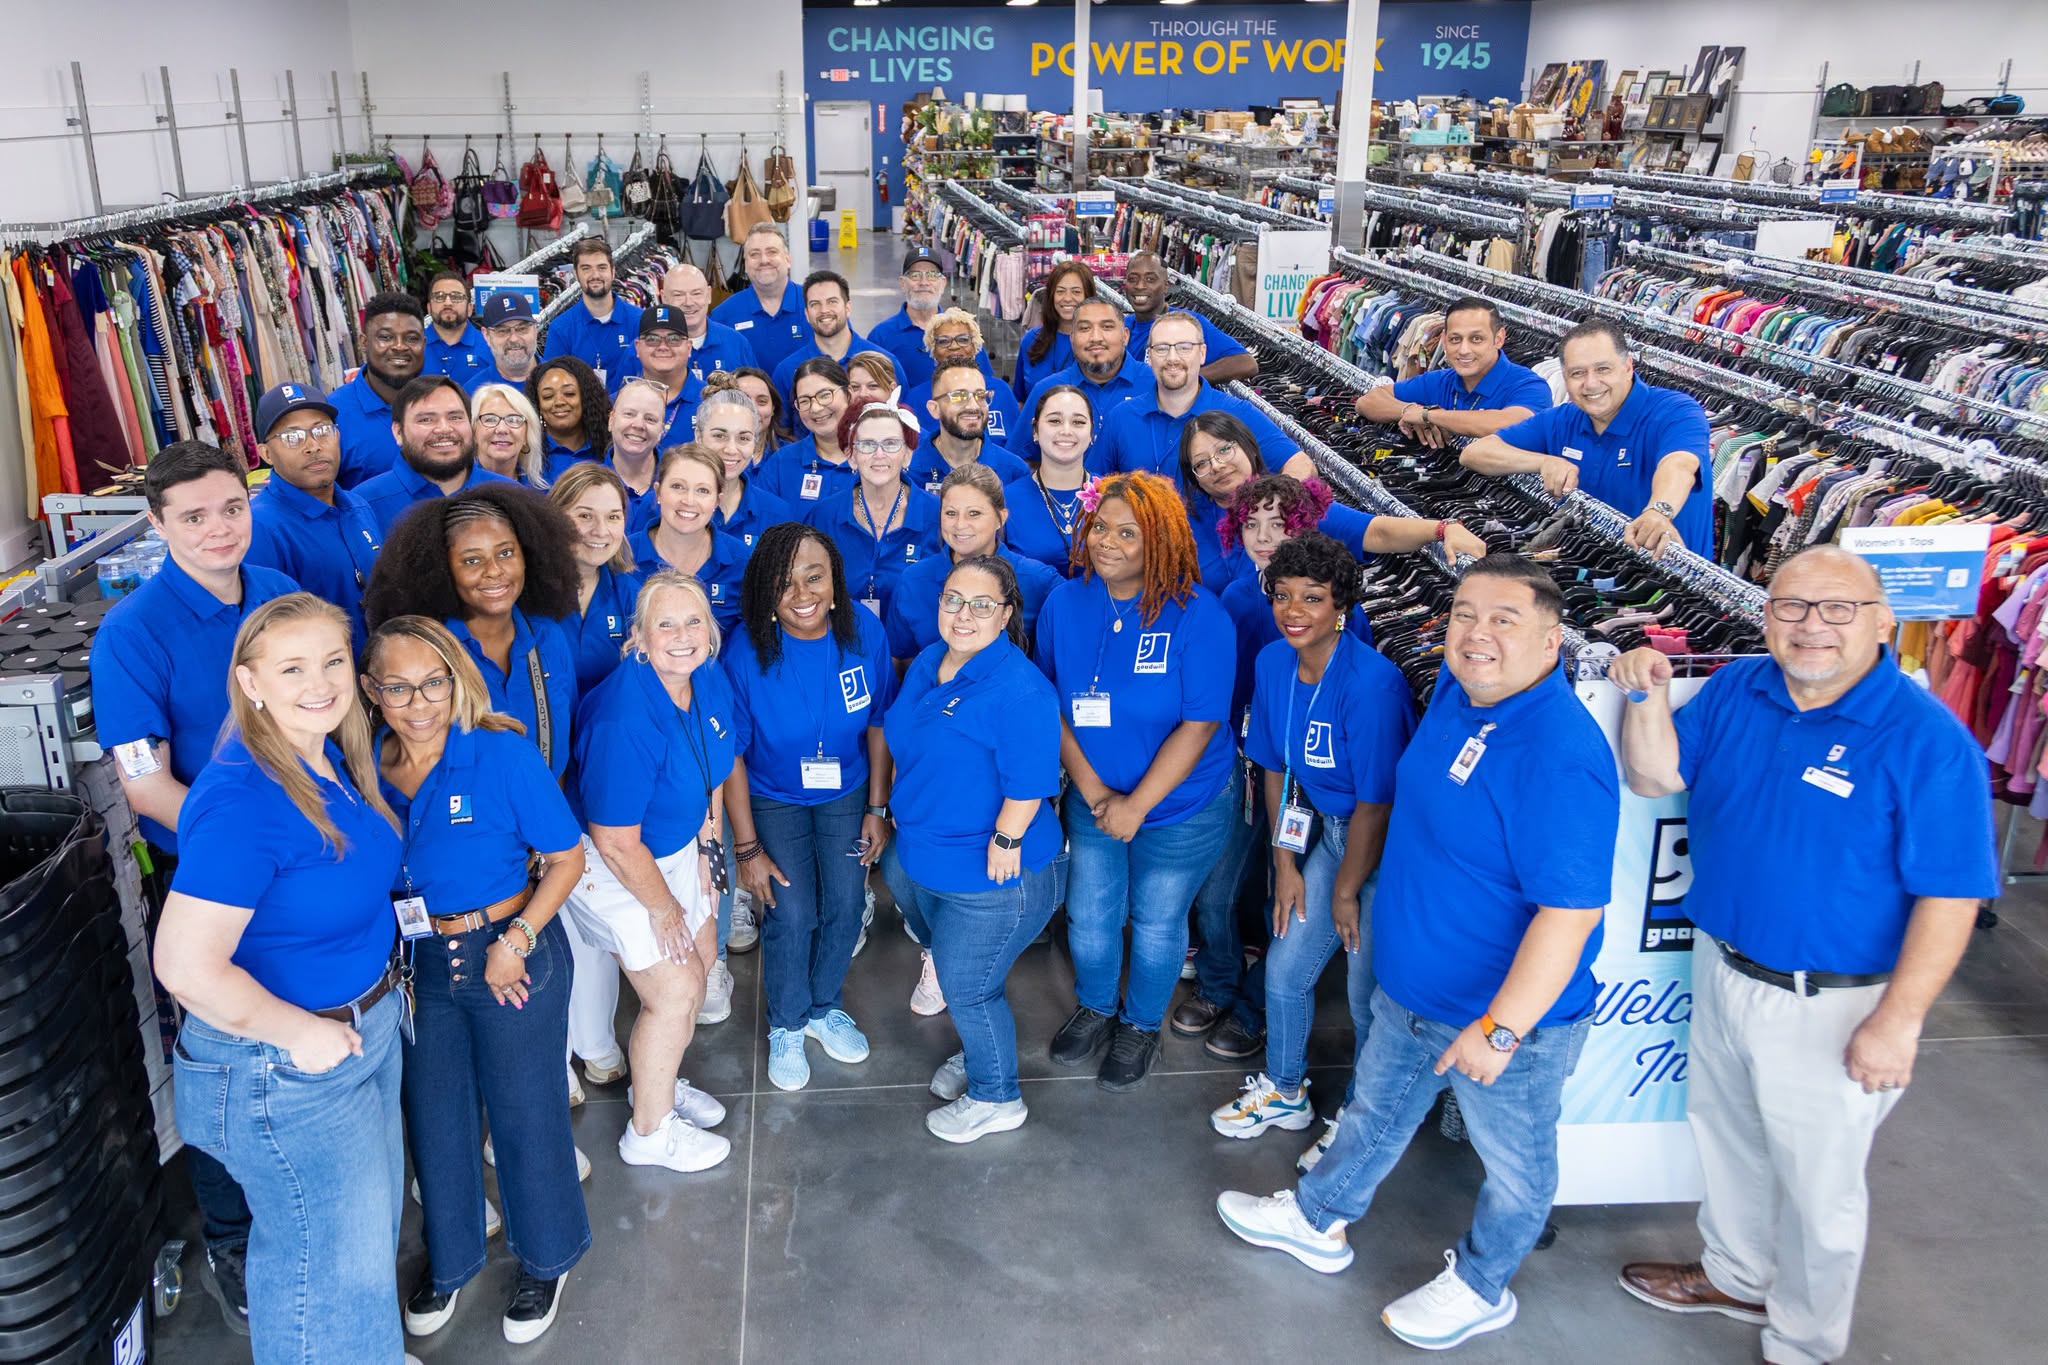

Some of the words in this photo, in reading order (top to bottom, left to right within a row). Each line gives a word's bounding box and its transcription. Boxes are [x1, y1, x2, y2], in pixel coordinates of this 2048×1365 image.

[827, 26, 995, 52] CHANGING
[1150, 20, 1238, 37] THROUGH
[1243, 20, 1277, 36] THE
[1435, 25, 1480, 39] SINCE
[1031, 41, 1183, 76] POWER
[1193, 40, 1251, 75] OF
[1421, 42, 1491, 70] 1945
[870, 57, 953, 83] LIVES
[1264, 274, 1318, 291] CHANG
[1267, 292, 1303, 318] LIV
[1854, 538, 1904, 548] Women's
[1909, 537, 1934, 547] Tops
[531, 661, 542, 690] ALDO
[1136, 663, 1165, 671] goodwill
[1306, 756, 1333, 764] goodwill
[1591, 978, 1693, 1026] Welc
[1628, 1038, 1688, 1097] In
